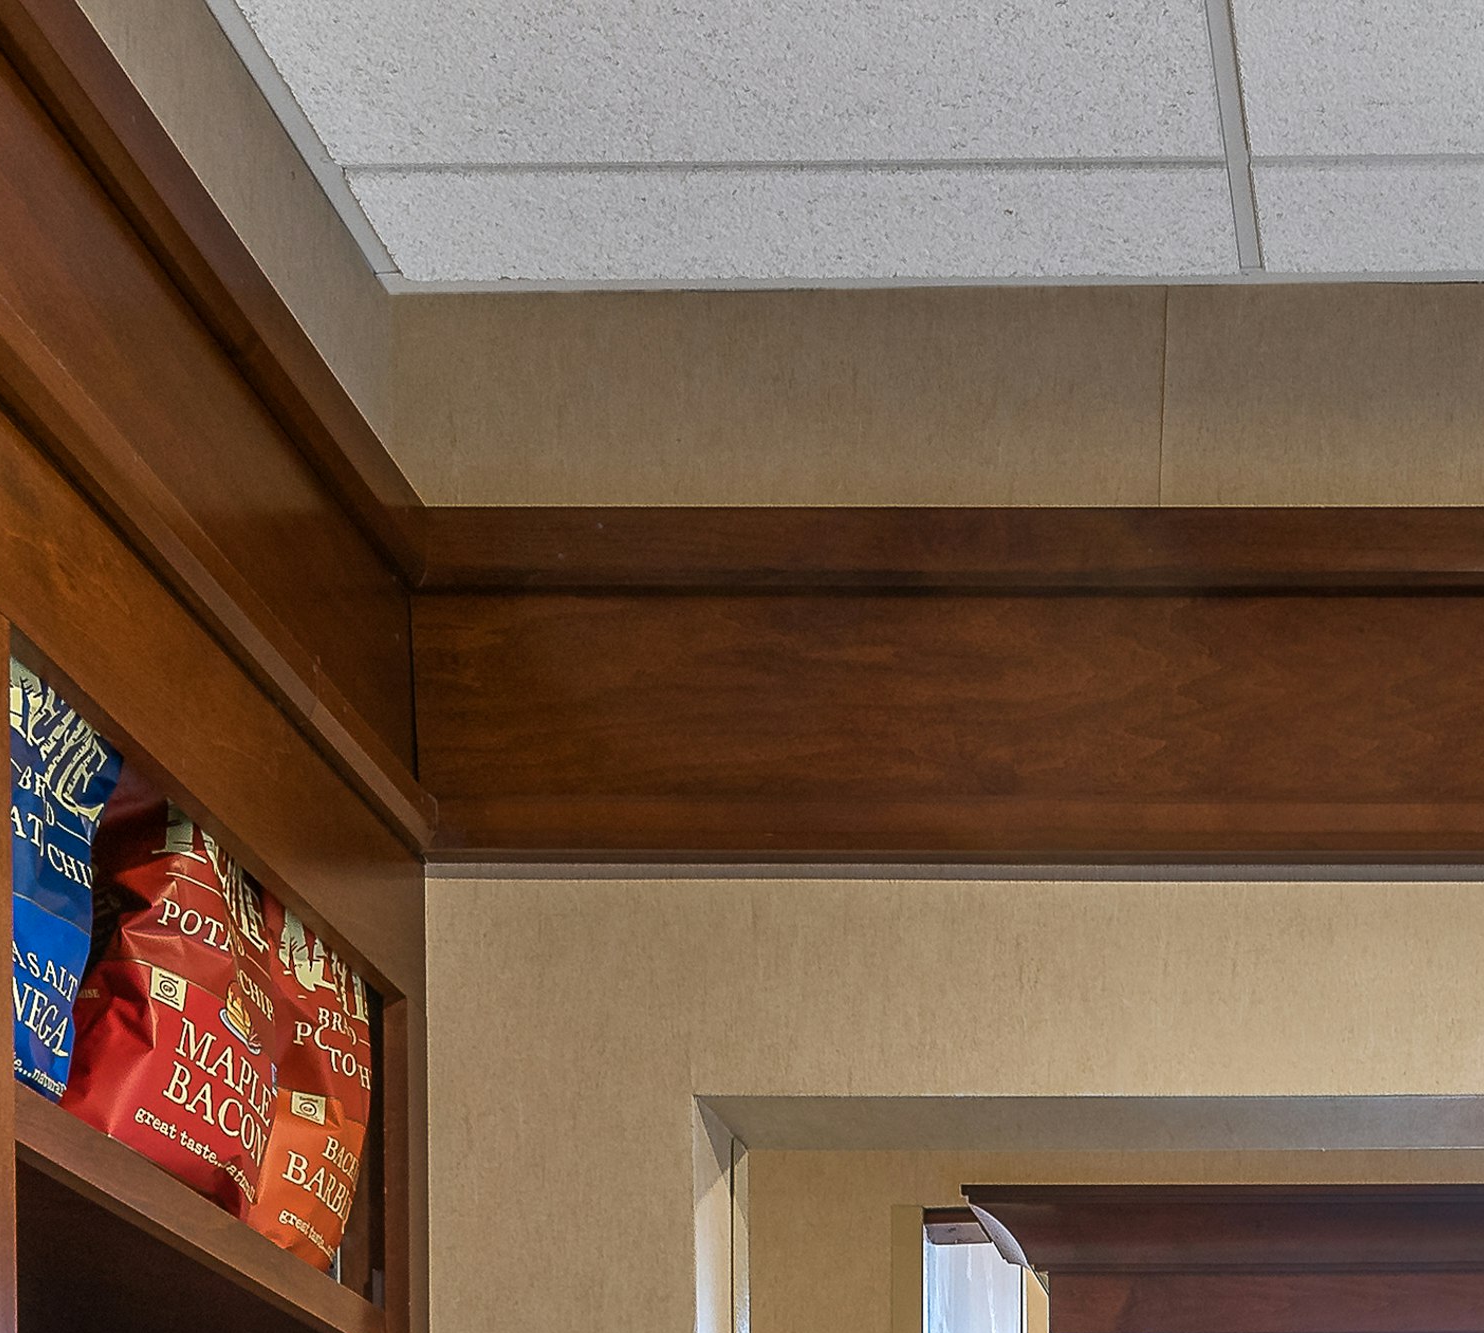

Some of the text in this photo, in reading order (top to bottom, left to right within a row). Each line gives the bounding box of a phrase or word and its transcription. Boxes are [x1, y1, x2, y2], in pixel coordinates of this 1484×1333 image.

[134, 1107, 178, 1141] great
[162, 1061, 268, 1168] BACON
[175, 1017, 273, 1128] MAPLE
